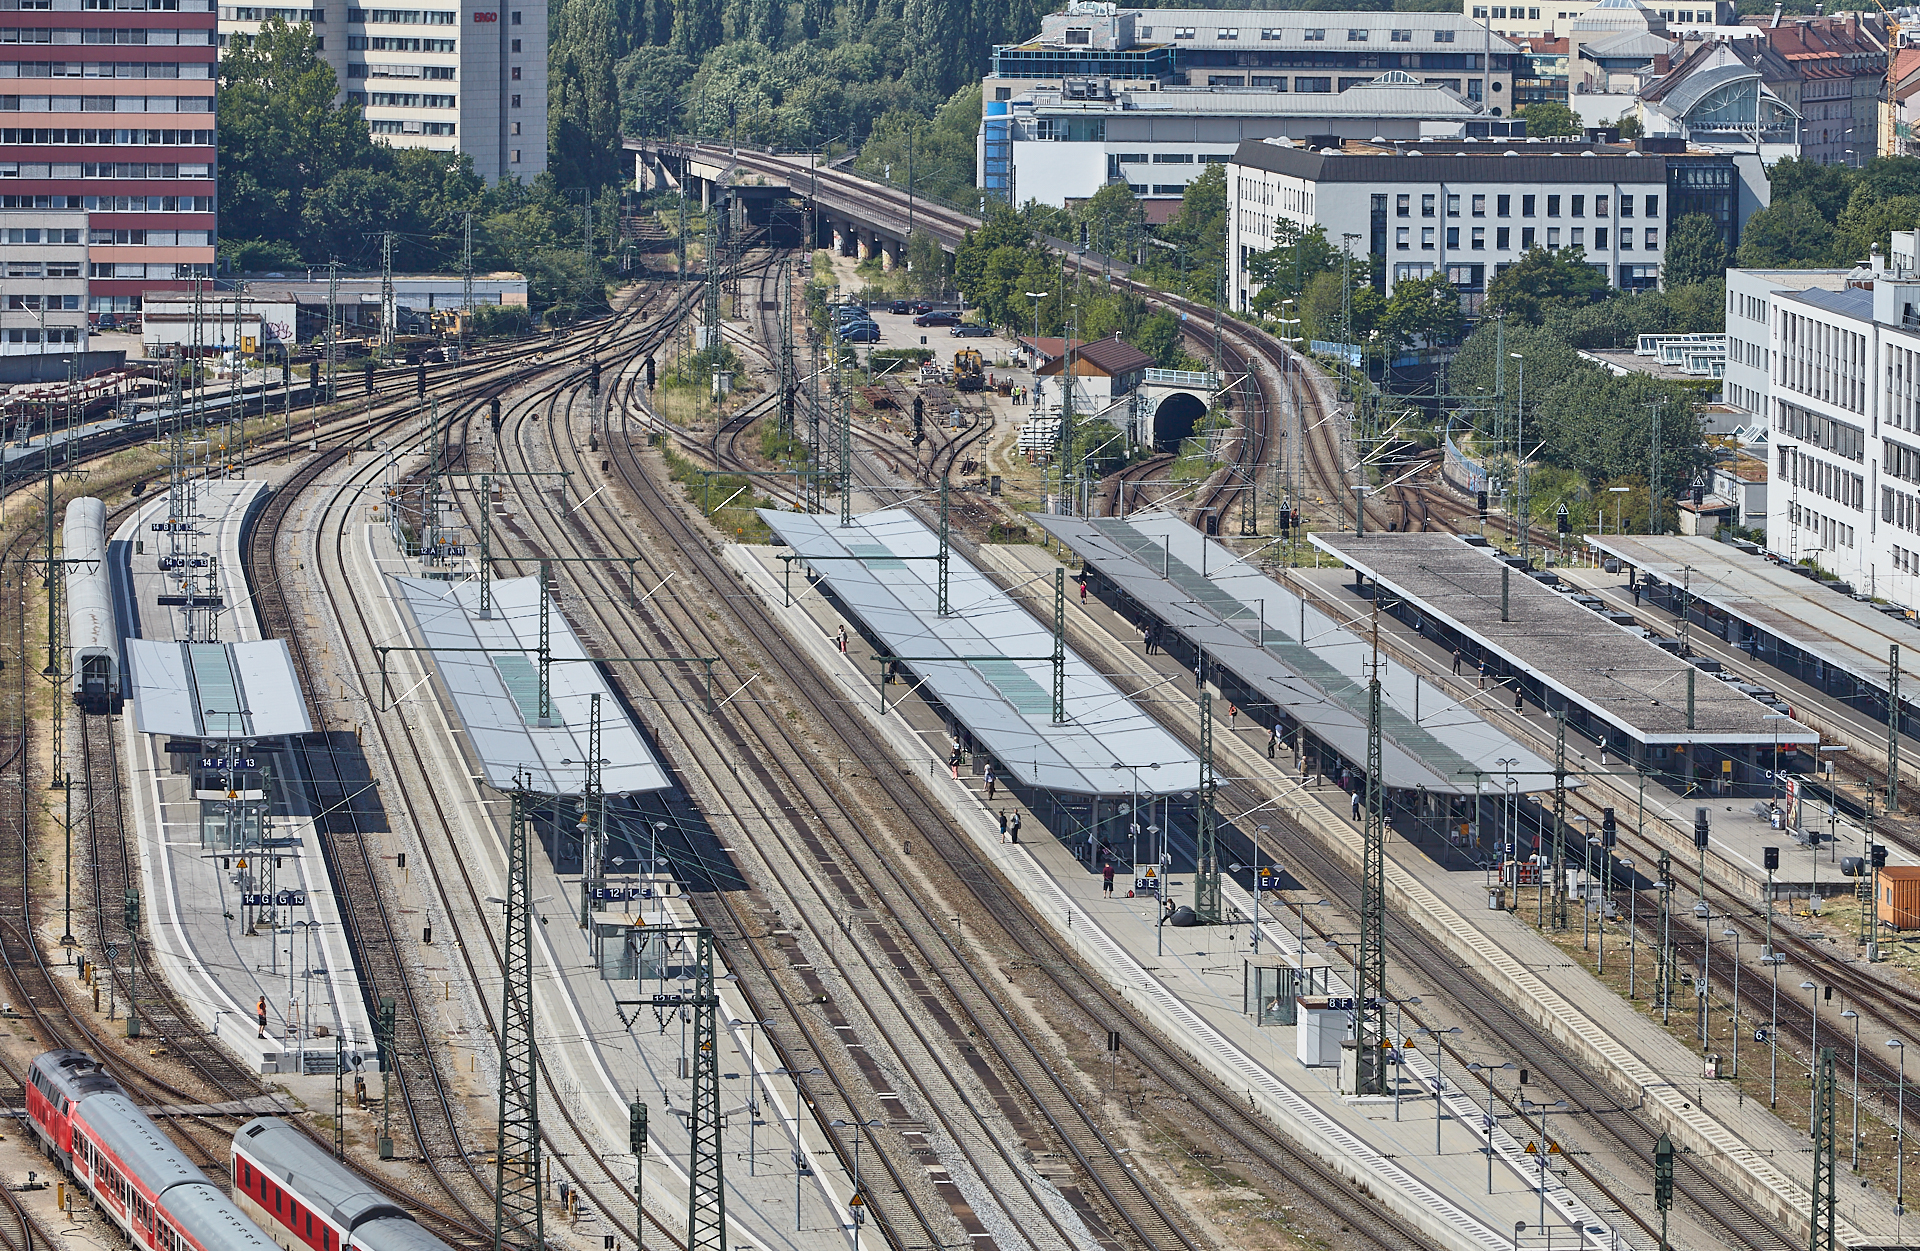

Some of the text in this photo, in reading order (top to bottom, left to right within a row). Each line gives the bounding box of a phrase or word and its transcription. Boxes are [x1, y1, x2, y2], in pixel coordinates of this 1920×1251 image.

[474, 12, 498, 22] ERGO
[430, 547, 436, 555] A
[202, 758, 223, 767] 14 F
[234, 758, 255, 767] F 13
[1765, 770, 1772, 778] C
[1780, 770, 1787, 778] C
[1505, 843, 1512, 852] E
[1136, 879, 1155, 888] 8 E
[1262, 877, 1280, 887] E 7
[596, 888, 620, 898] E 12
[244, 895, 269, 904] 14 G
[1695, 978, 1706, 987] 10
[1329, 998, 1348, 1008] 8 F
[1755, 1030, 1764, 1040] 6
